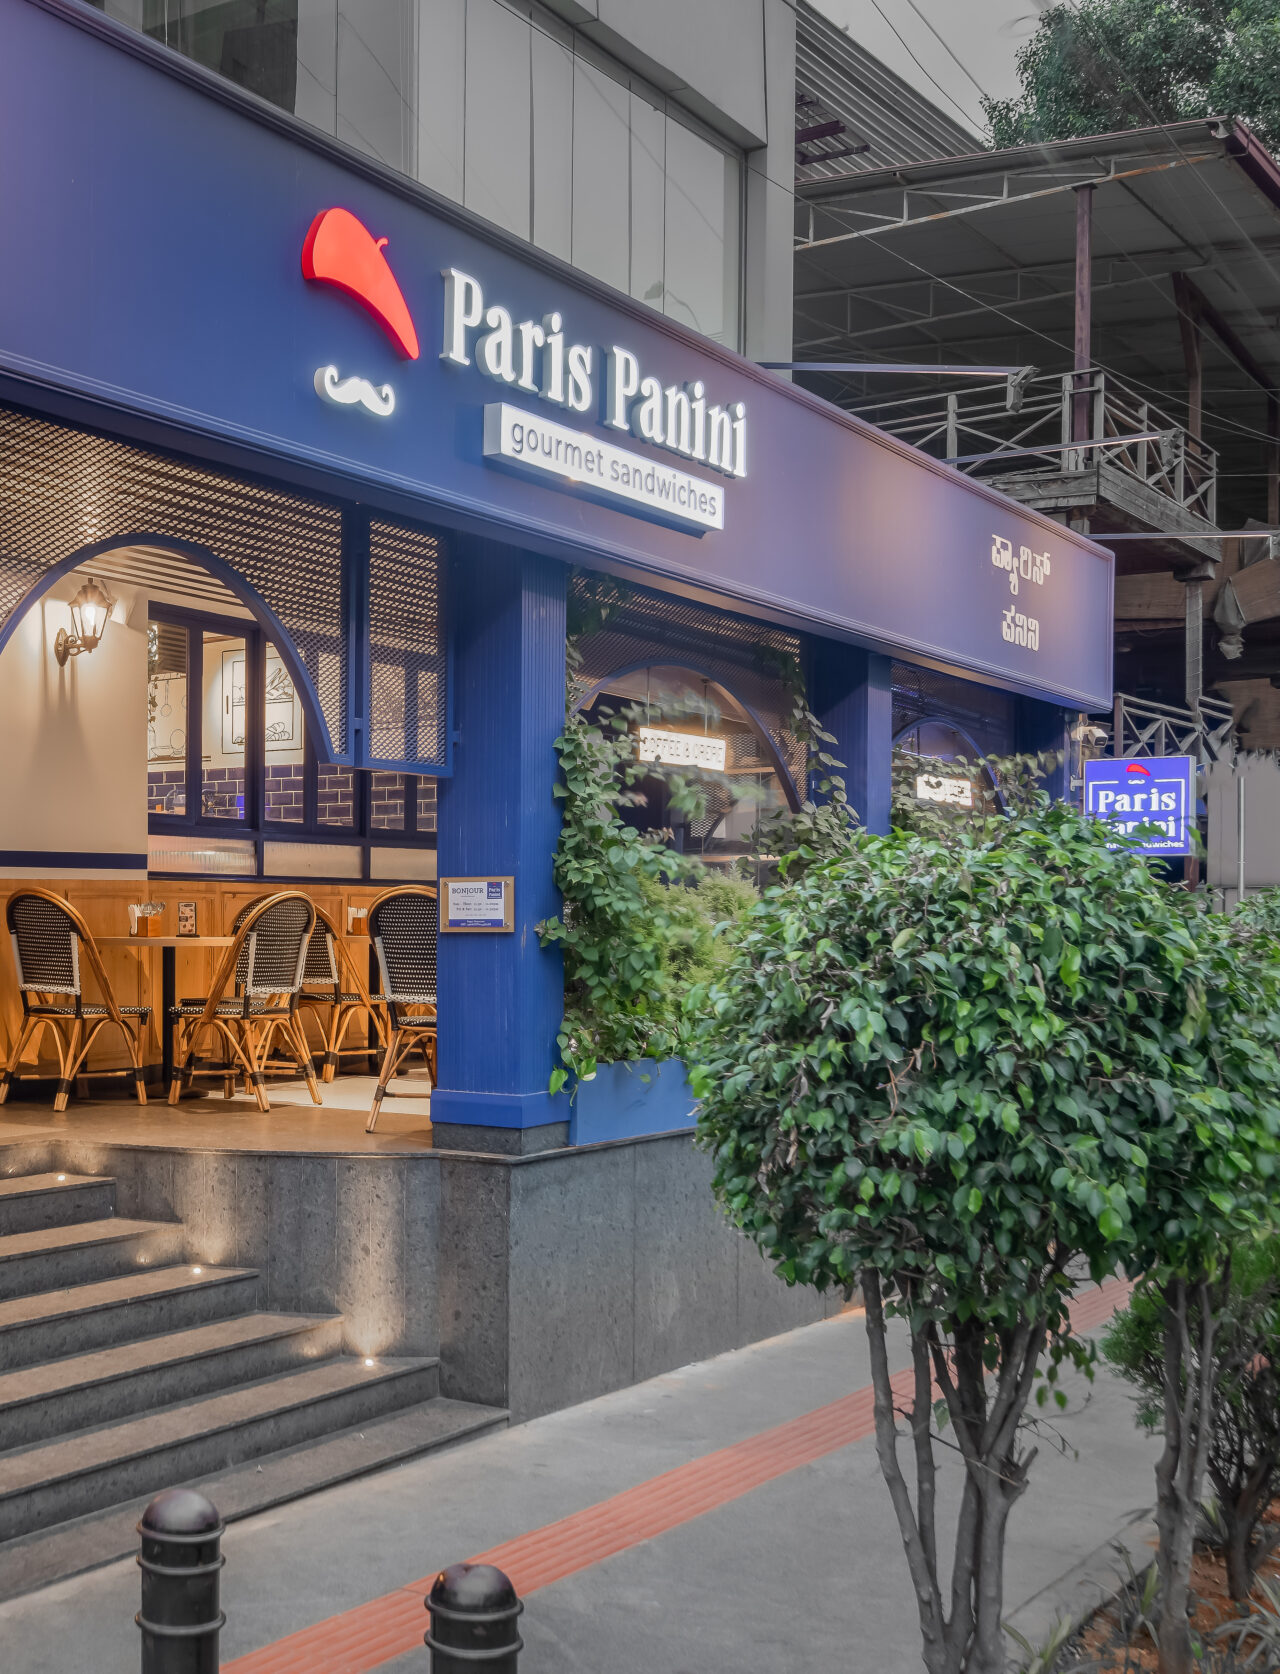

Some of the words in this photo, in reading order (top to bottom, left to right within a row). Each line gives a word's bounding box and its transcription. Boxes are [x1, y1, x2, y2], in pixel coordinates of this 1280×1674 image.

[440, 267, 593, 412] Paris
[607, 345, 747, 478] Panini
[511, 422, 604, 477] gourmet
[610, 456, 718, 517] sandwiches
[1097, 788, 1177, 813] Paris
